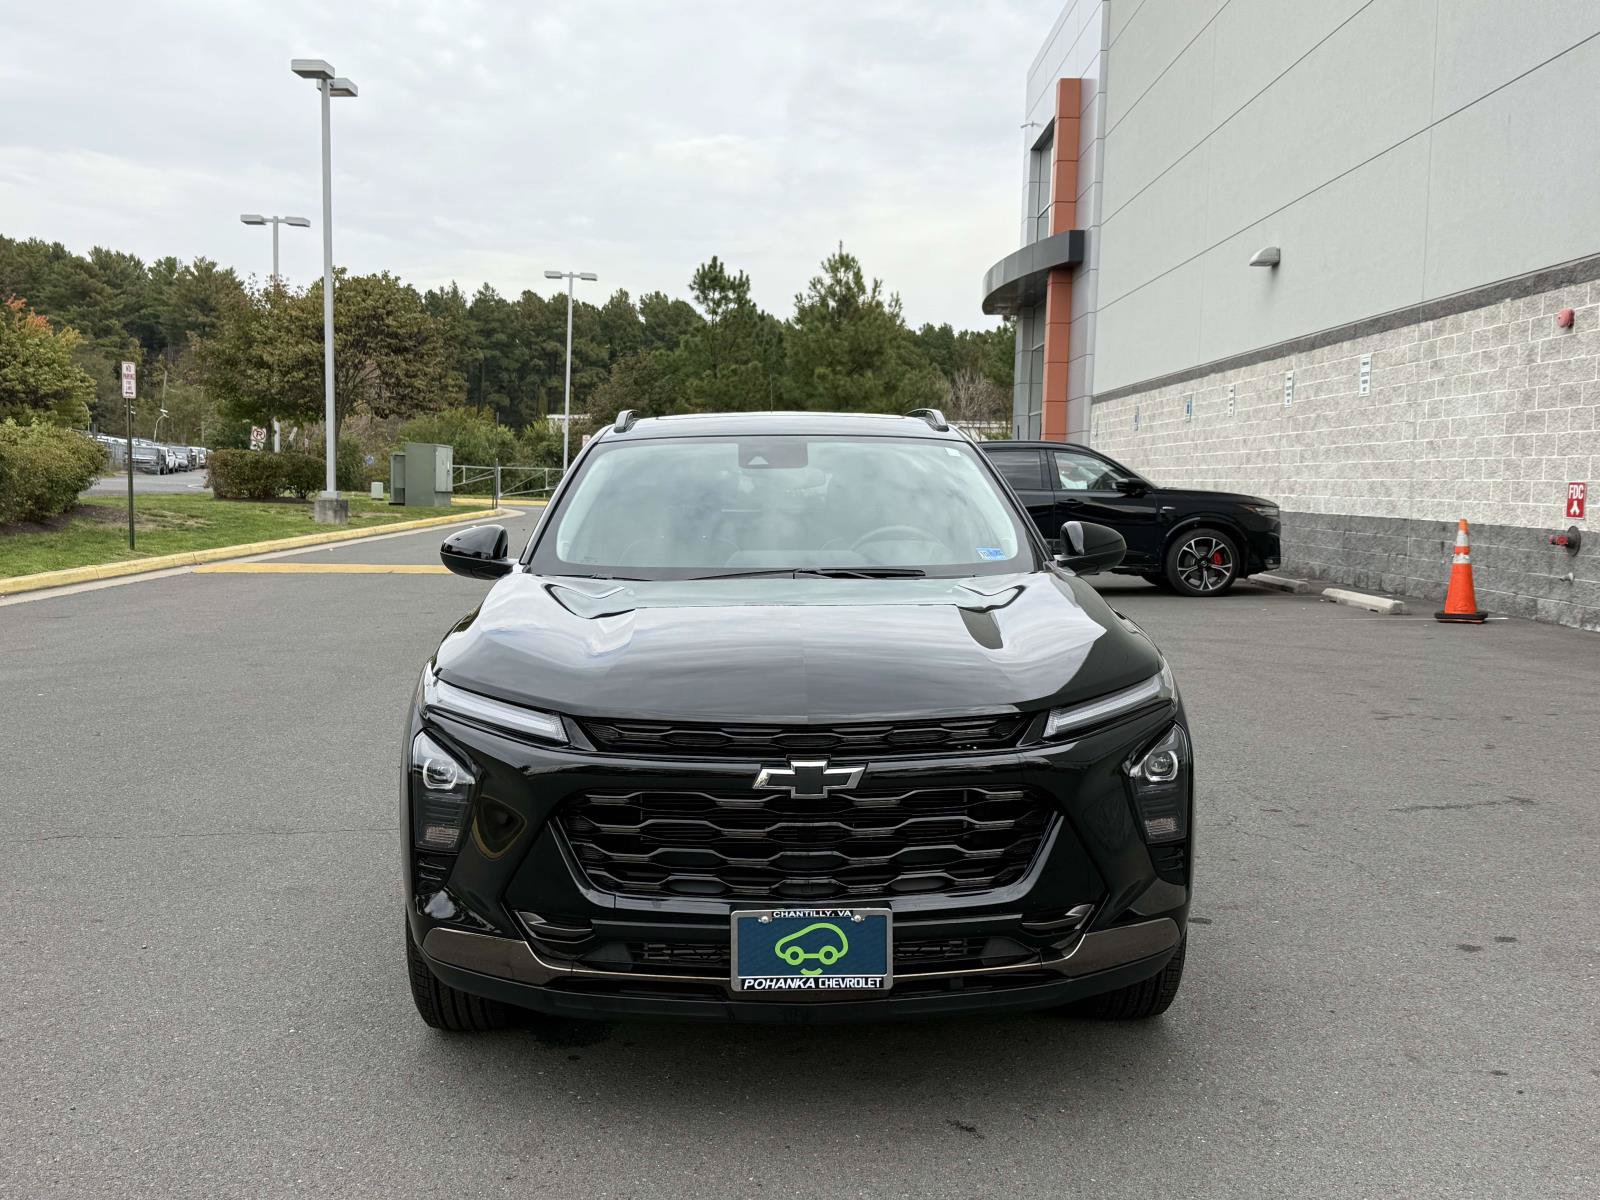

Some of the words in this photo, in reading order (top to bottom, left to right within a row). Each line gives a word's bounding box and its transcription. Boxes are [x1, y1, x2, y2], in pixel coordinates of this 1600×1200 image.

[1569, 484, 1584, 499] FDC
[744, 978, 816, 989] POHANKA
[818, 977, 882, 988] CHEVROLET
